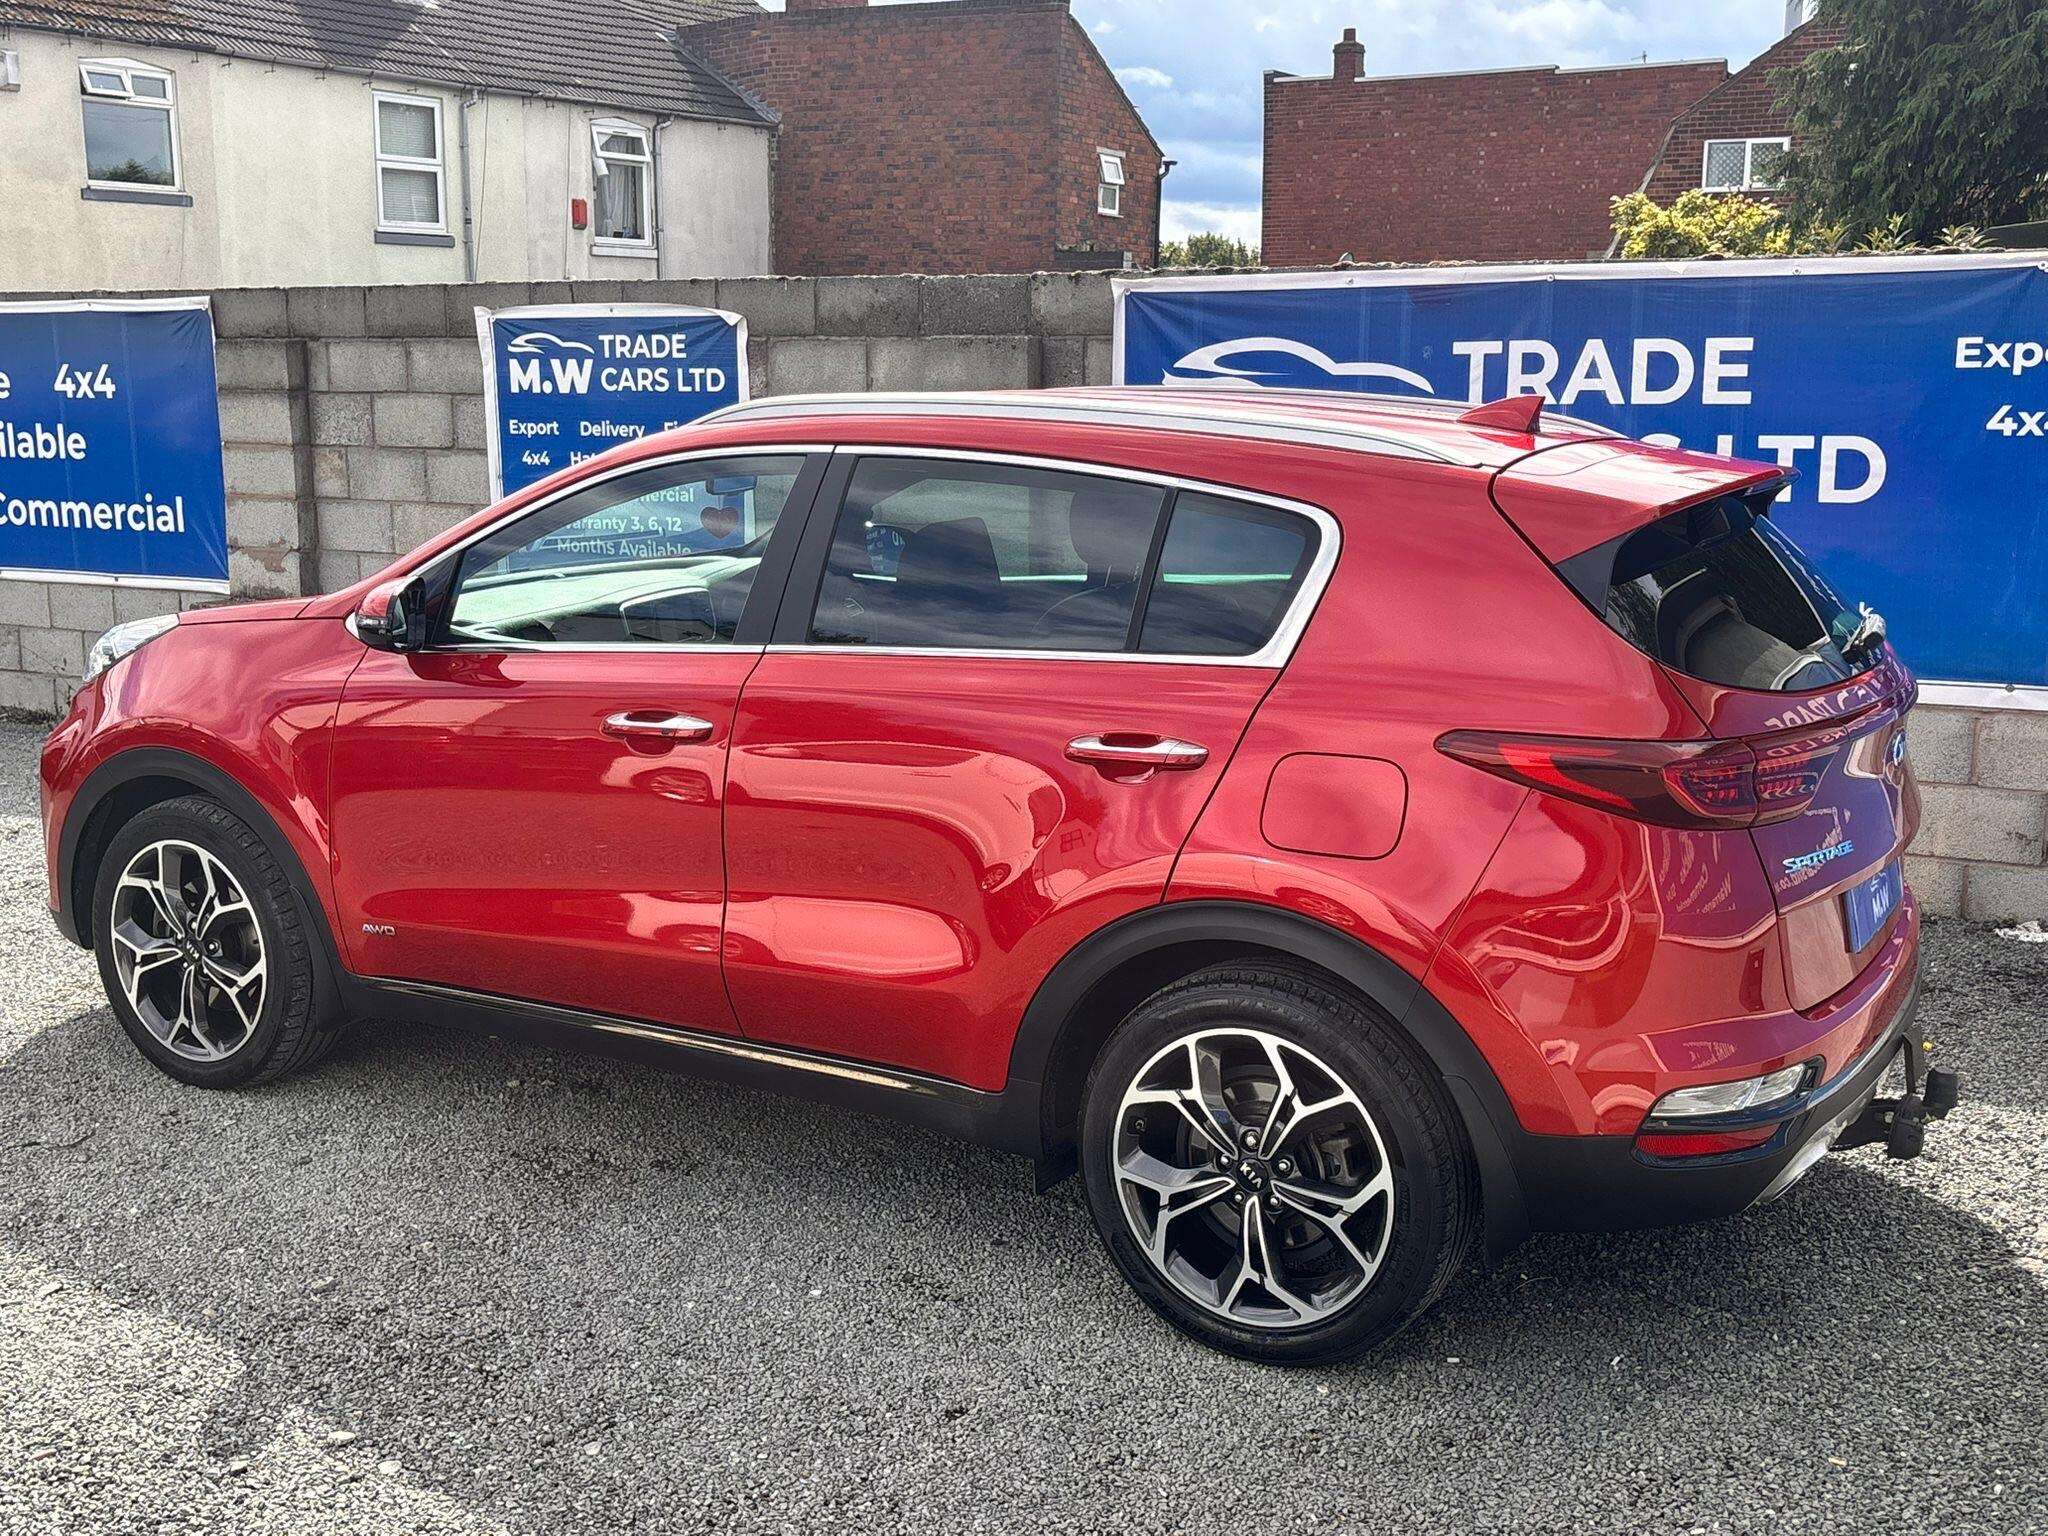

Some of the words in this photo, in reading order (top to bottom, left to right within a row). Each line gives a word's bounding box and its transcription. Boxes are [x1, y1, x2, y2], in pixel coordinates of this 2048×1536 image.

[598, 334, 687, 359] TRADE
[1955, 336, 2048, 376] Exp
[54, 363, 116, 399] 4x4
[507, 358, 594, 394] M.W
[600, 367, 670, 392] CARS
[677, 367, 726, 393] LTD
[1452, 337, 1754, 405] TRADE
[509, 419, 560, 439] Export
[580, 420, 645, 440] Delivery
[1985, 404, 2048, 437] 4x
[522, 450, 551, 466] 4x4
[630, 516, 645, 533] 3,
[648, 516, 663, 533] 6,
[666, 517, 683, 532] 12
[557, 539, 616, 555] Months
[619, 539, 692, 558] Available
[1782, 840, 1855, 874] SPORTAGE
[362, 923, 396, 936] AWD
[1240, 1161, 1262, 1189] KIA
